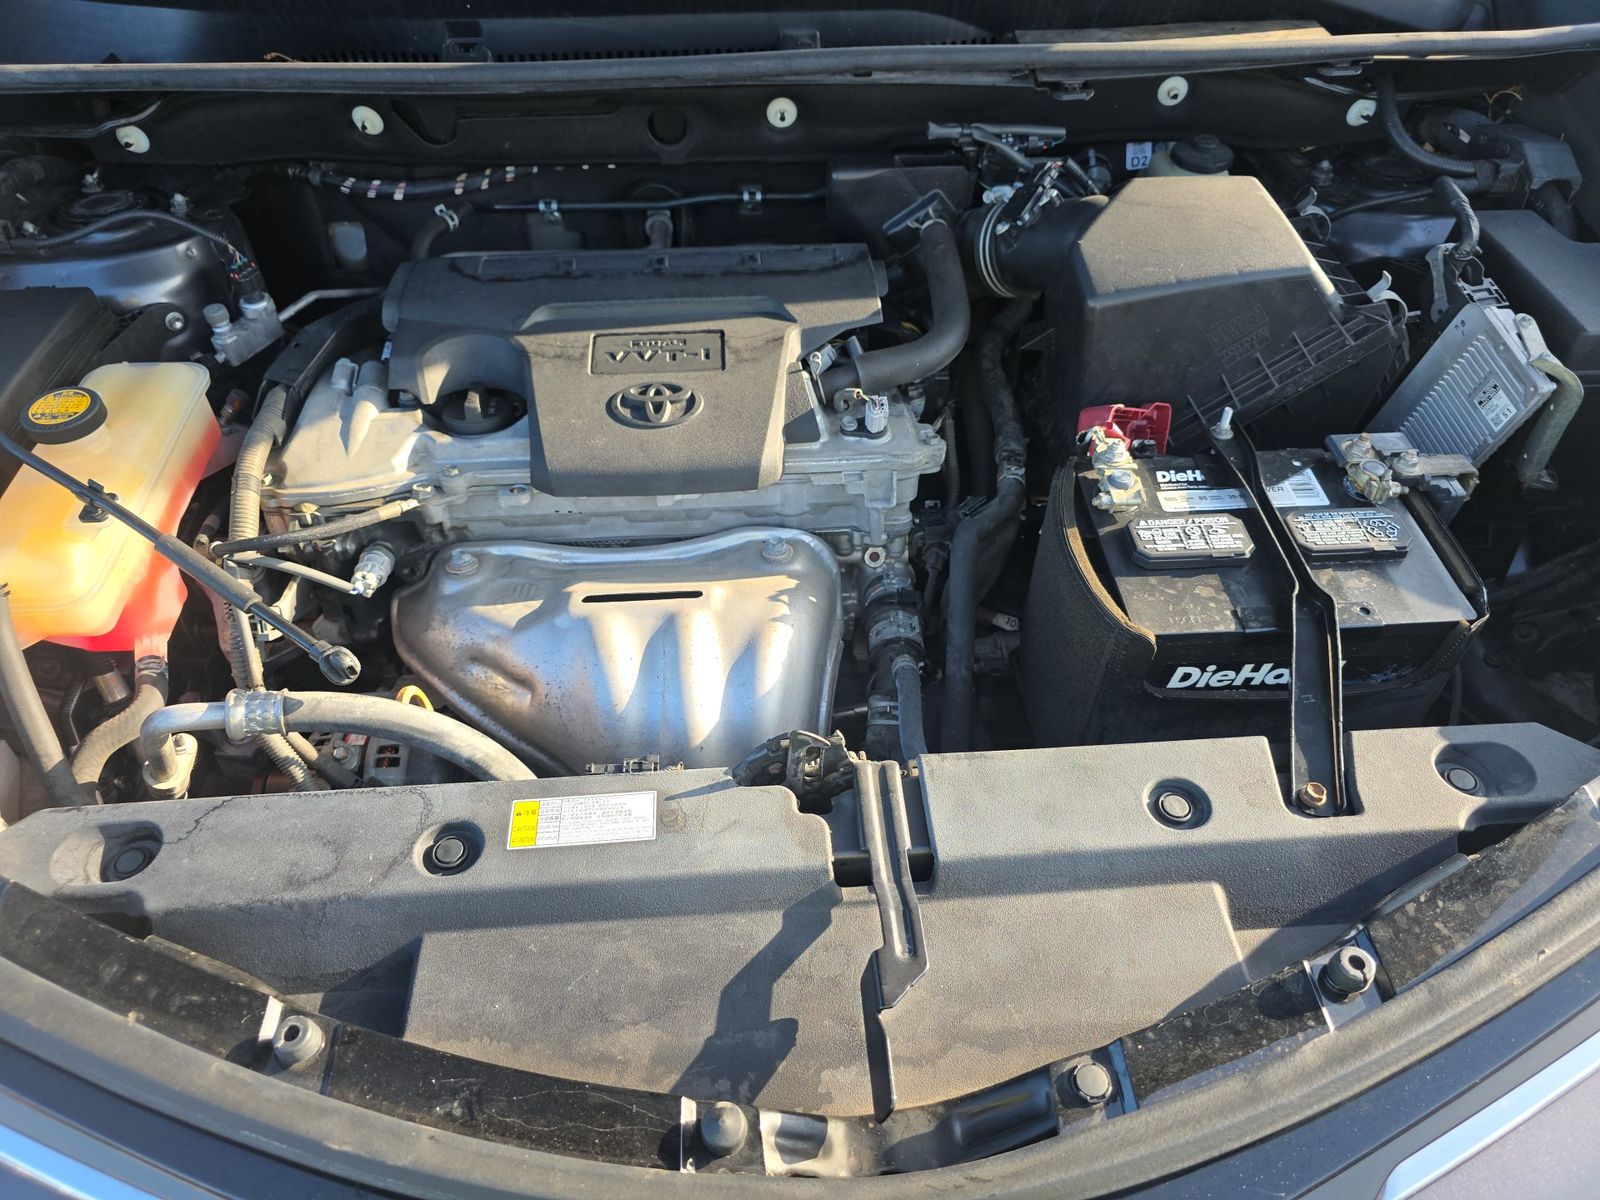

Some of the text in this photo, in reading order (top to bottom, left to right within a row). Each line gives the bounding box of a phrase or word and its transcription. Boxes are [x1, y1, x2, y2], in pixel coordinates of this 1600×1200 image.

[1131, 156, 1148, 168] D2
[1156, 469, 1206, 482] DieH
[1147, 518, 1186, 526] DANGER
[1194, 516, 1230, 524] POISON
[1166, 662, 1347, 689] DieHa
